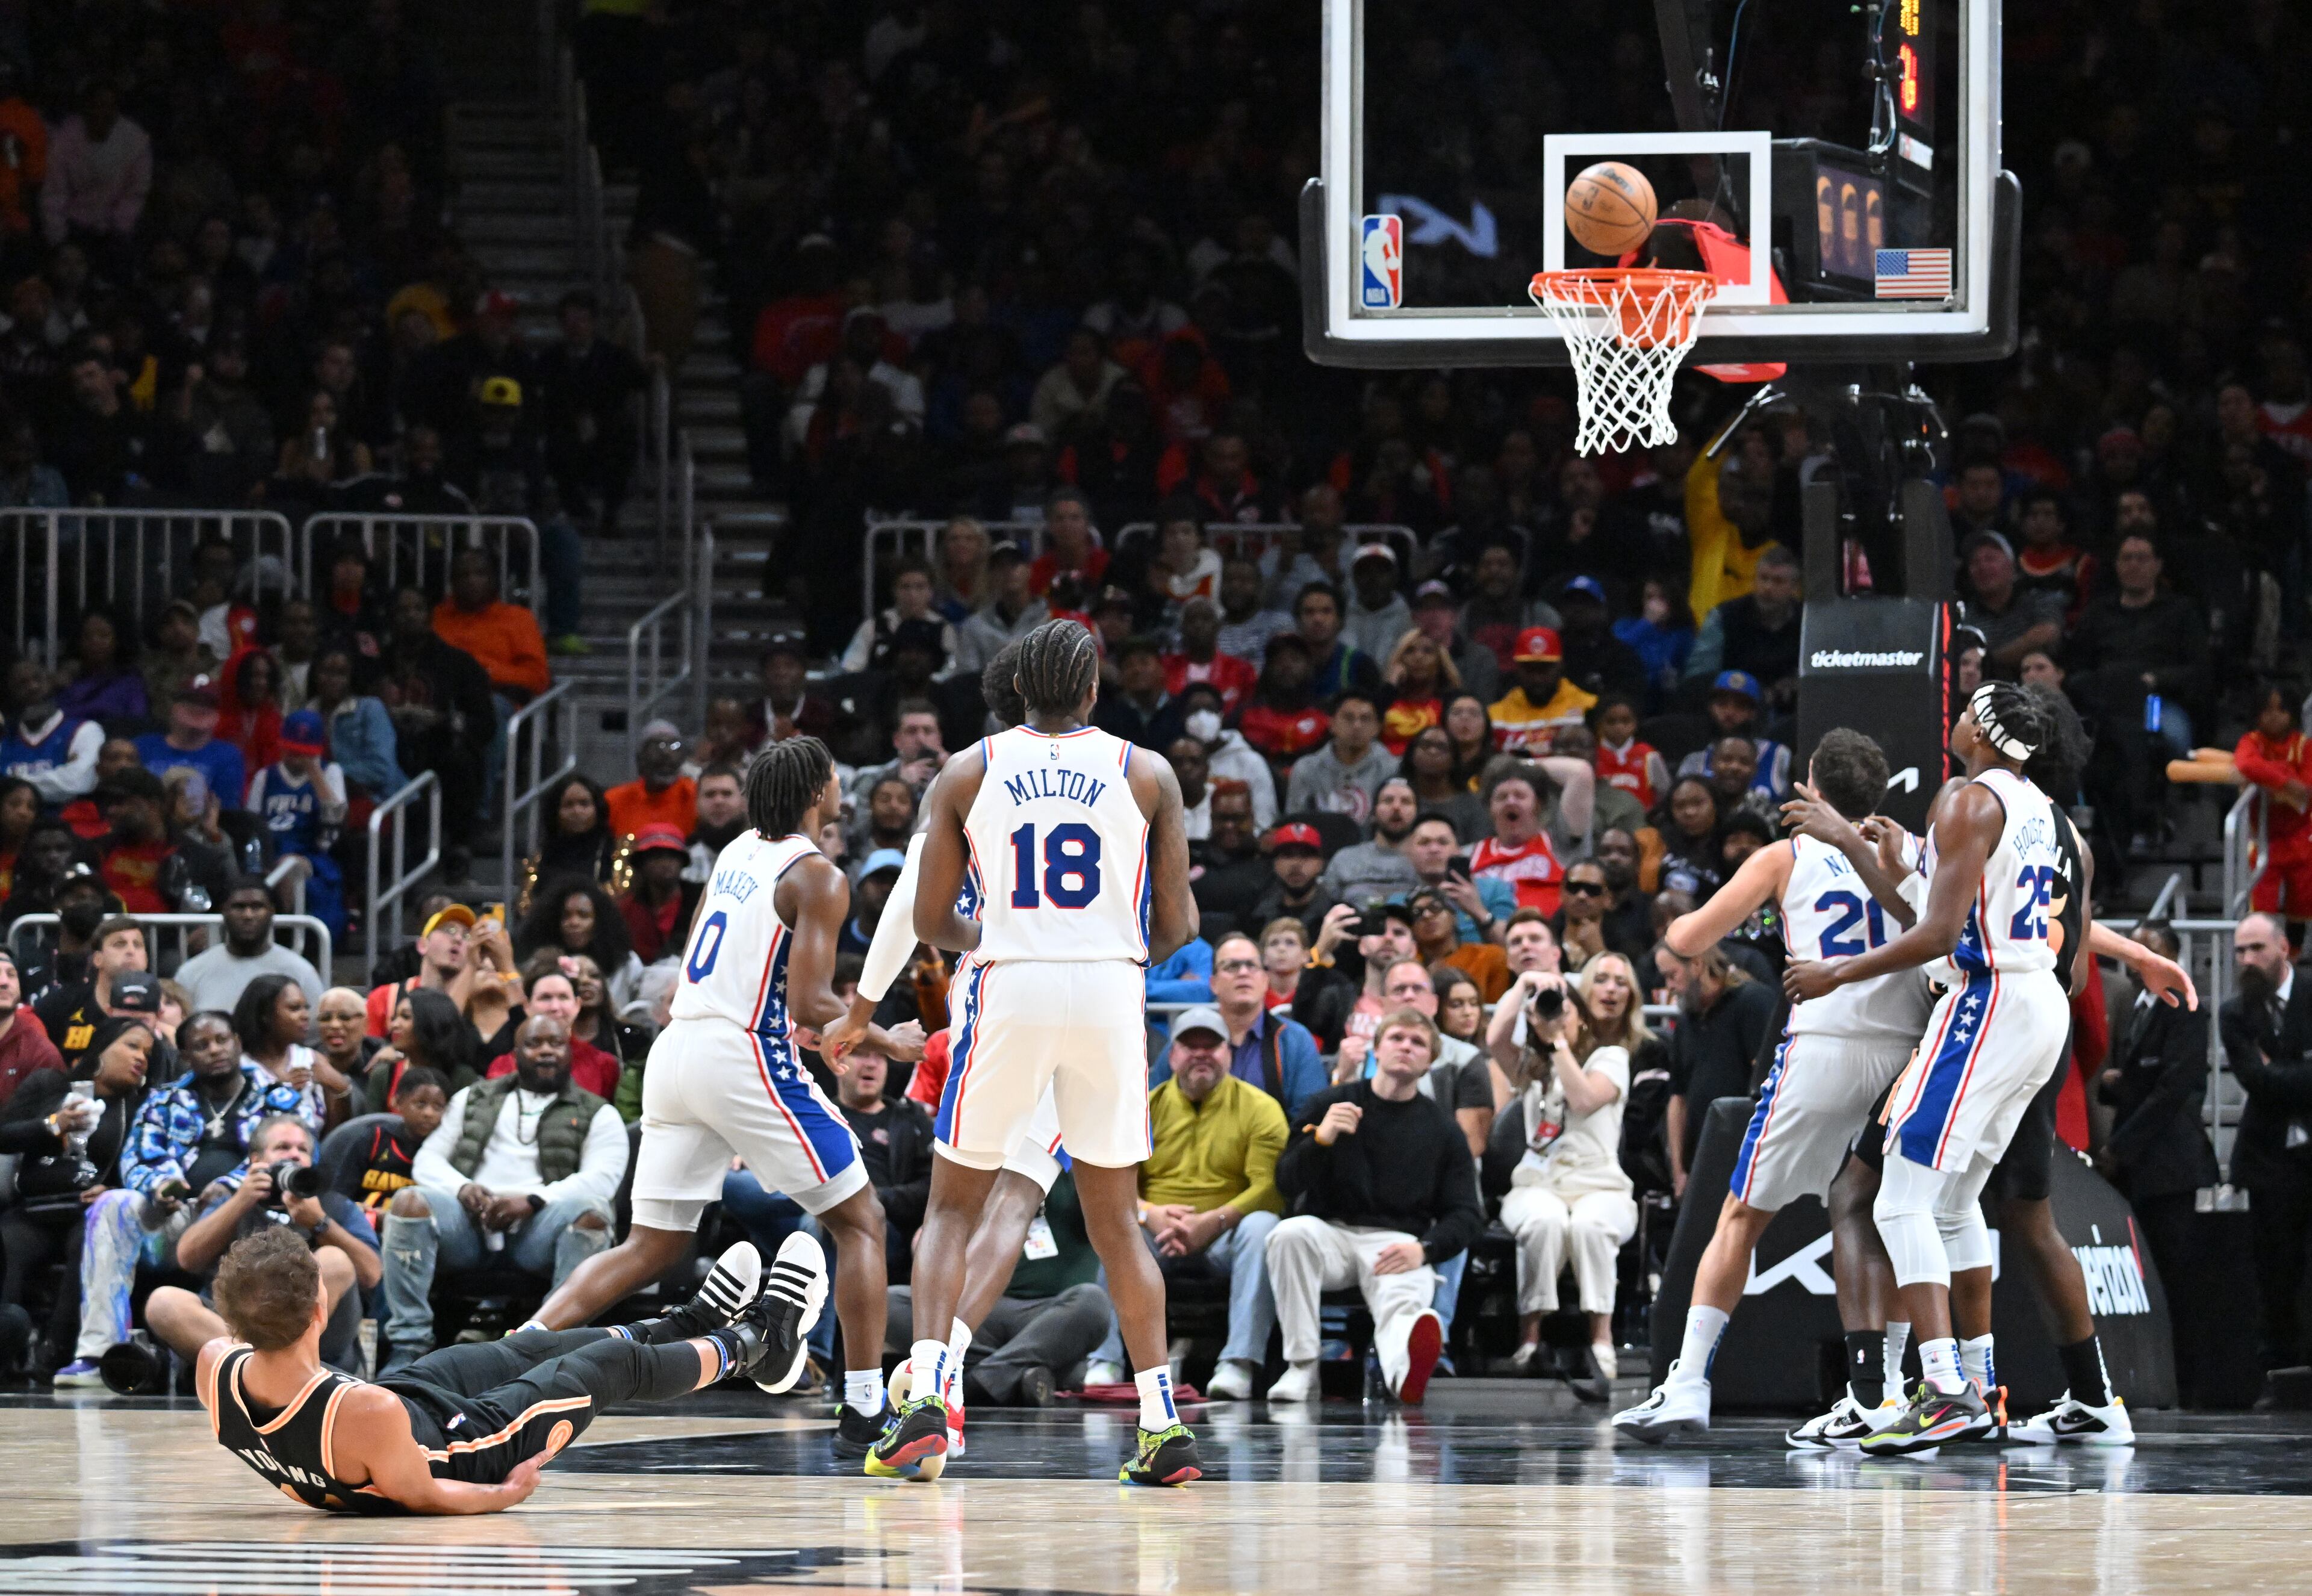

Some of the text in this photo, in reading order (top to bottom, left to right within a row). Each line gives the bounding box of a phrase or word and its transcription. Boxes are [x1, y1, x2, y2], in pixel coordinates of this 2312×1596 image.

[1811, 650, 1924, 668] ticketmaster
[1004, 769, 1107, 808] MILTON
[2013, 818, 2045, 861] HOUSE
[713, 870, 759, 904] MAXEY
[1010, 823, 1101, 910] 18
[2009, 865, 2054, 940] 25
[686, 910, 727, 984] 0
[238, 1449, 326, 1488] YOUNG
